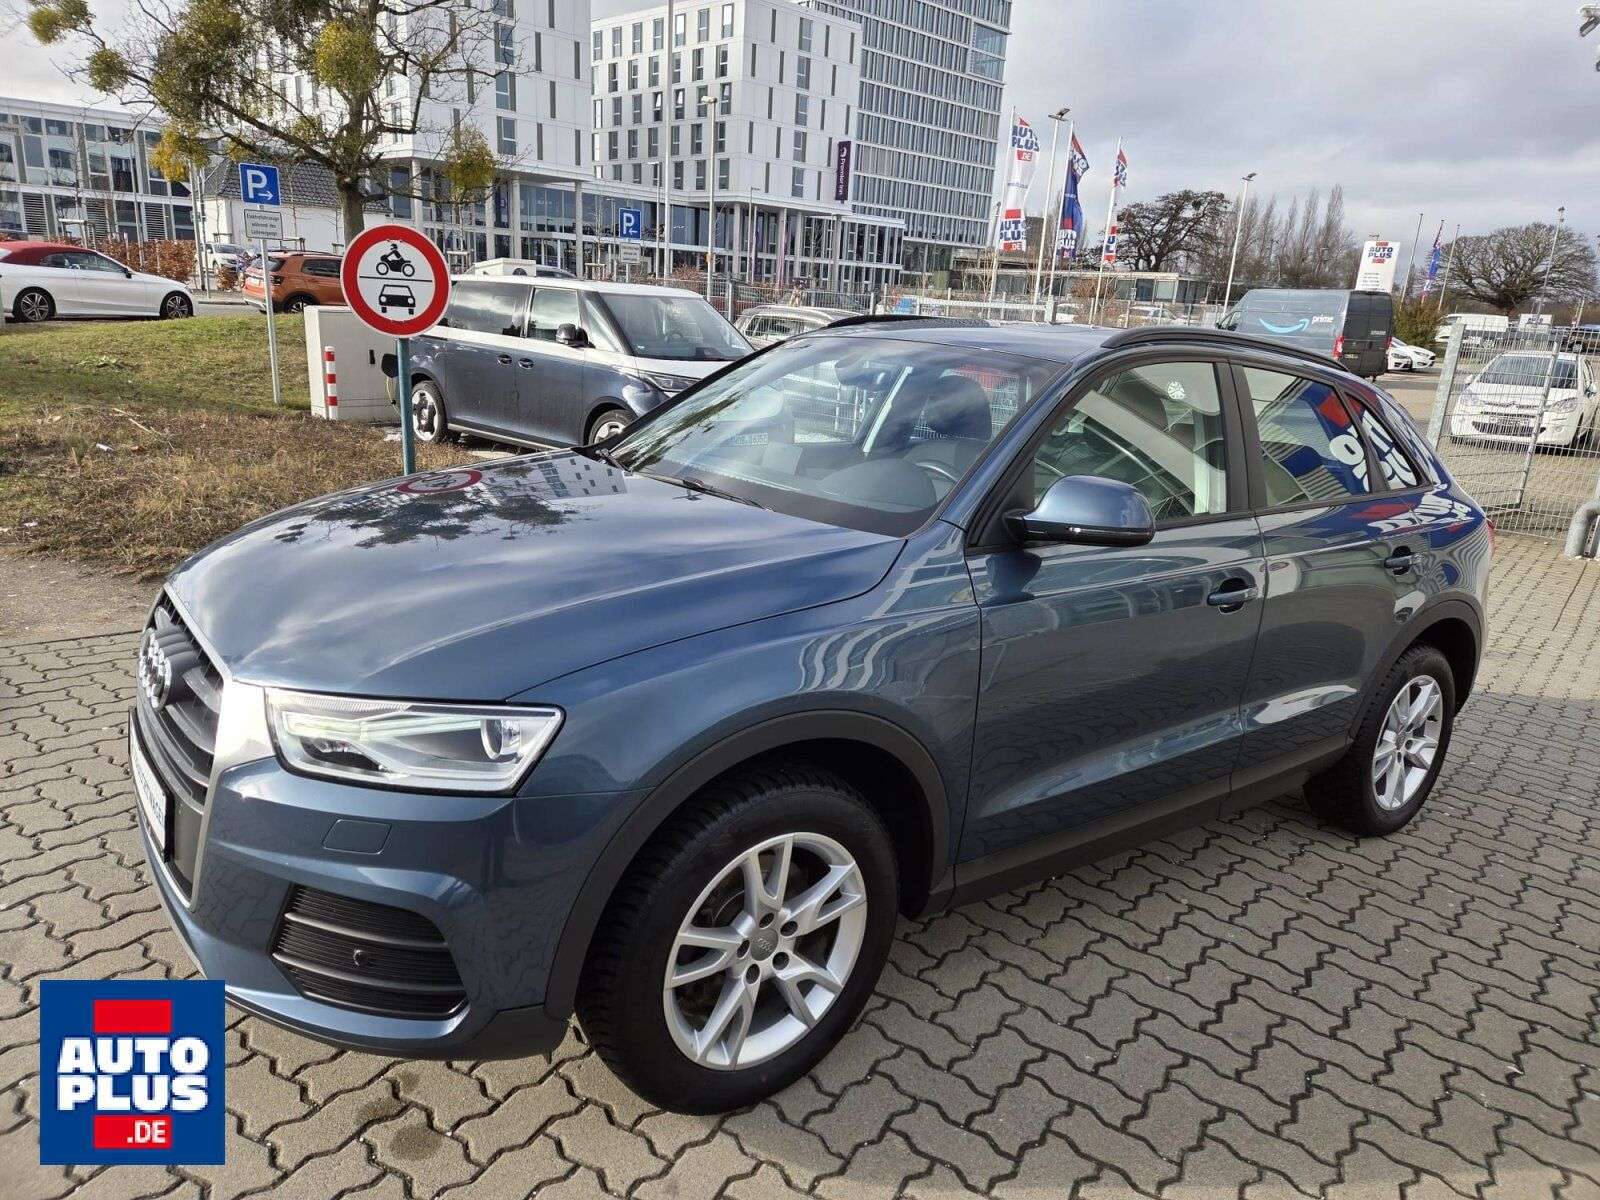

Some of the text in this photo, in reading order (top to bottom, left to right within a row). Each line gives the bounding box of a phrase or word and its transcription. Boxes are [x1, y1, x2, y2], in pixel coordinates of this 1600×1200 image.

[247, 169, 267, 198] P
[623, 212, 635, 234] P
[1311, 314, 1334, 325] prime
